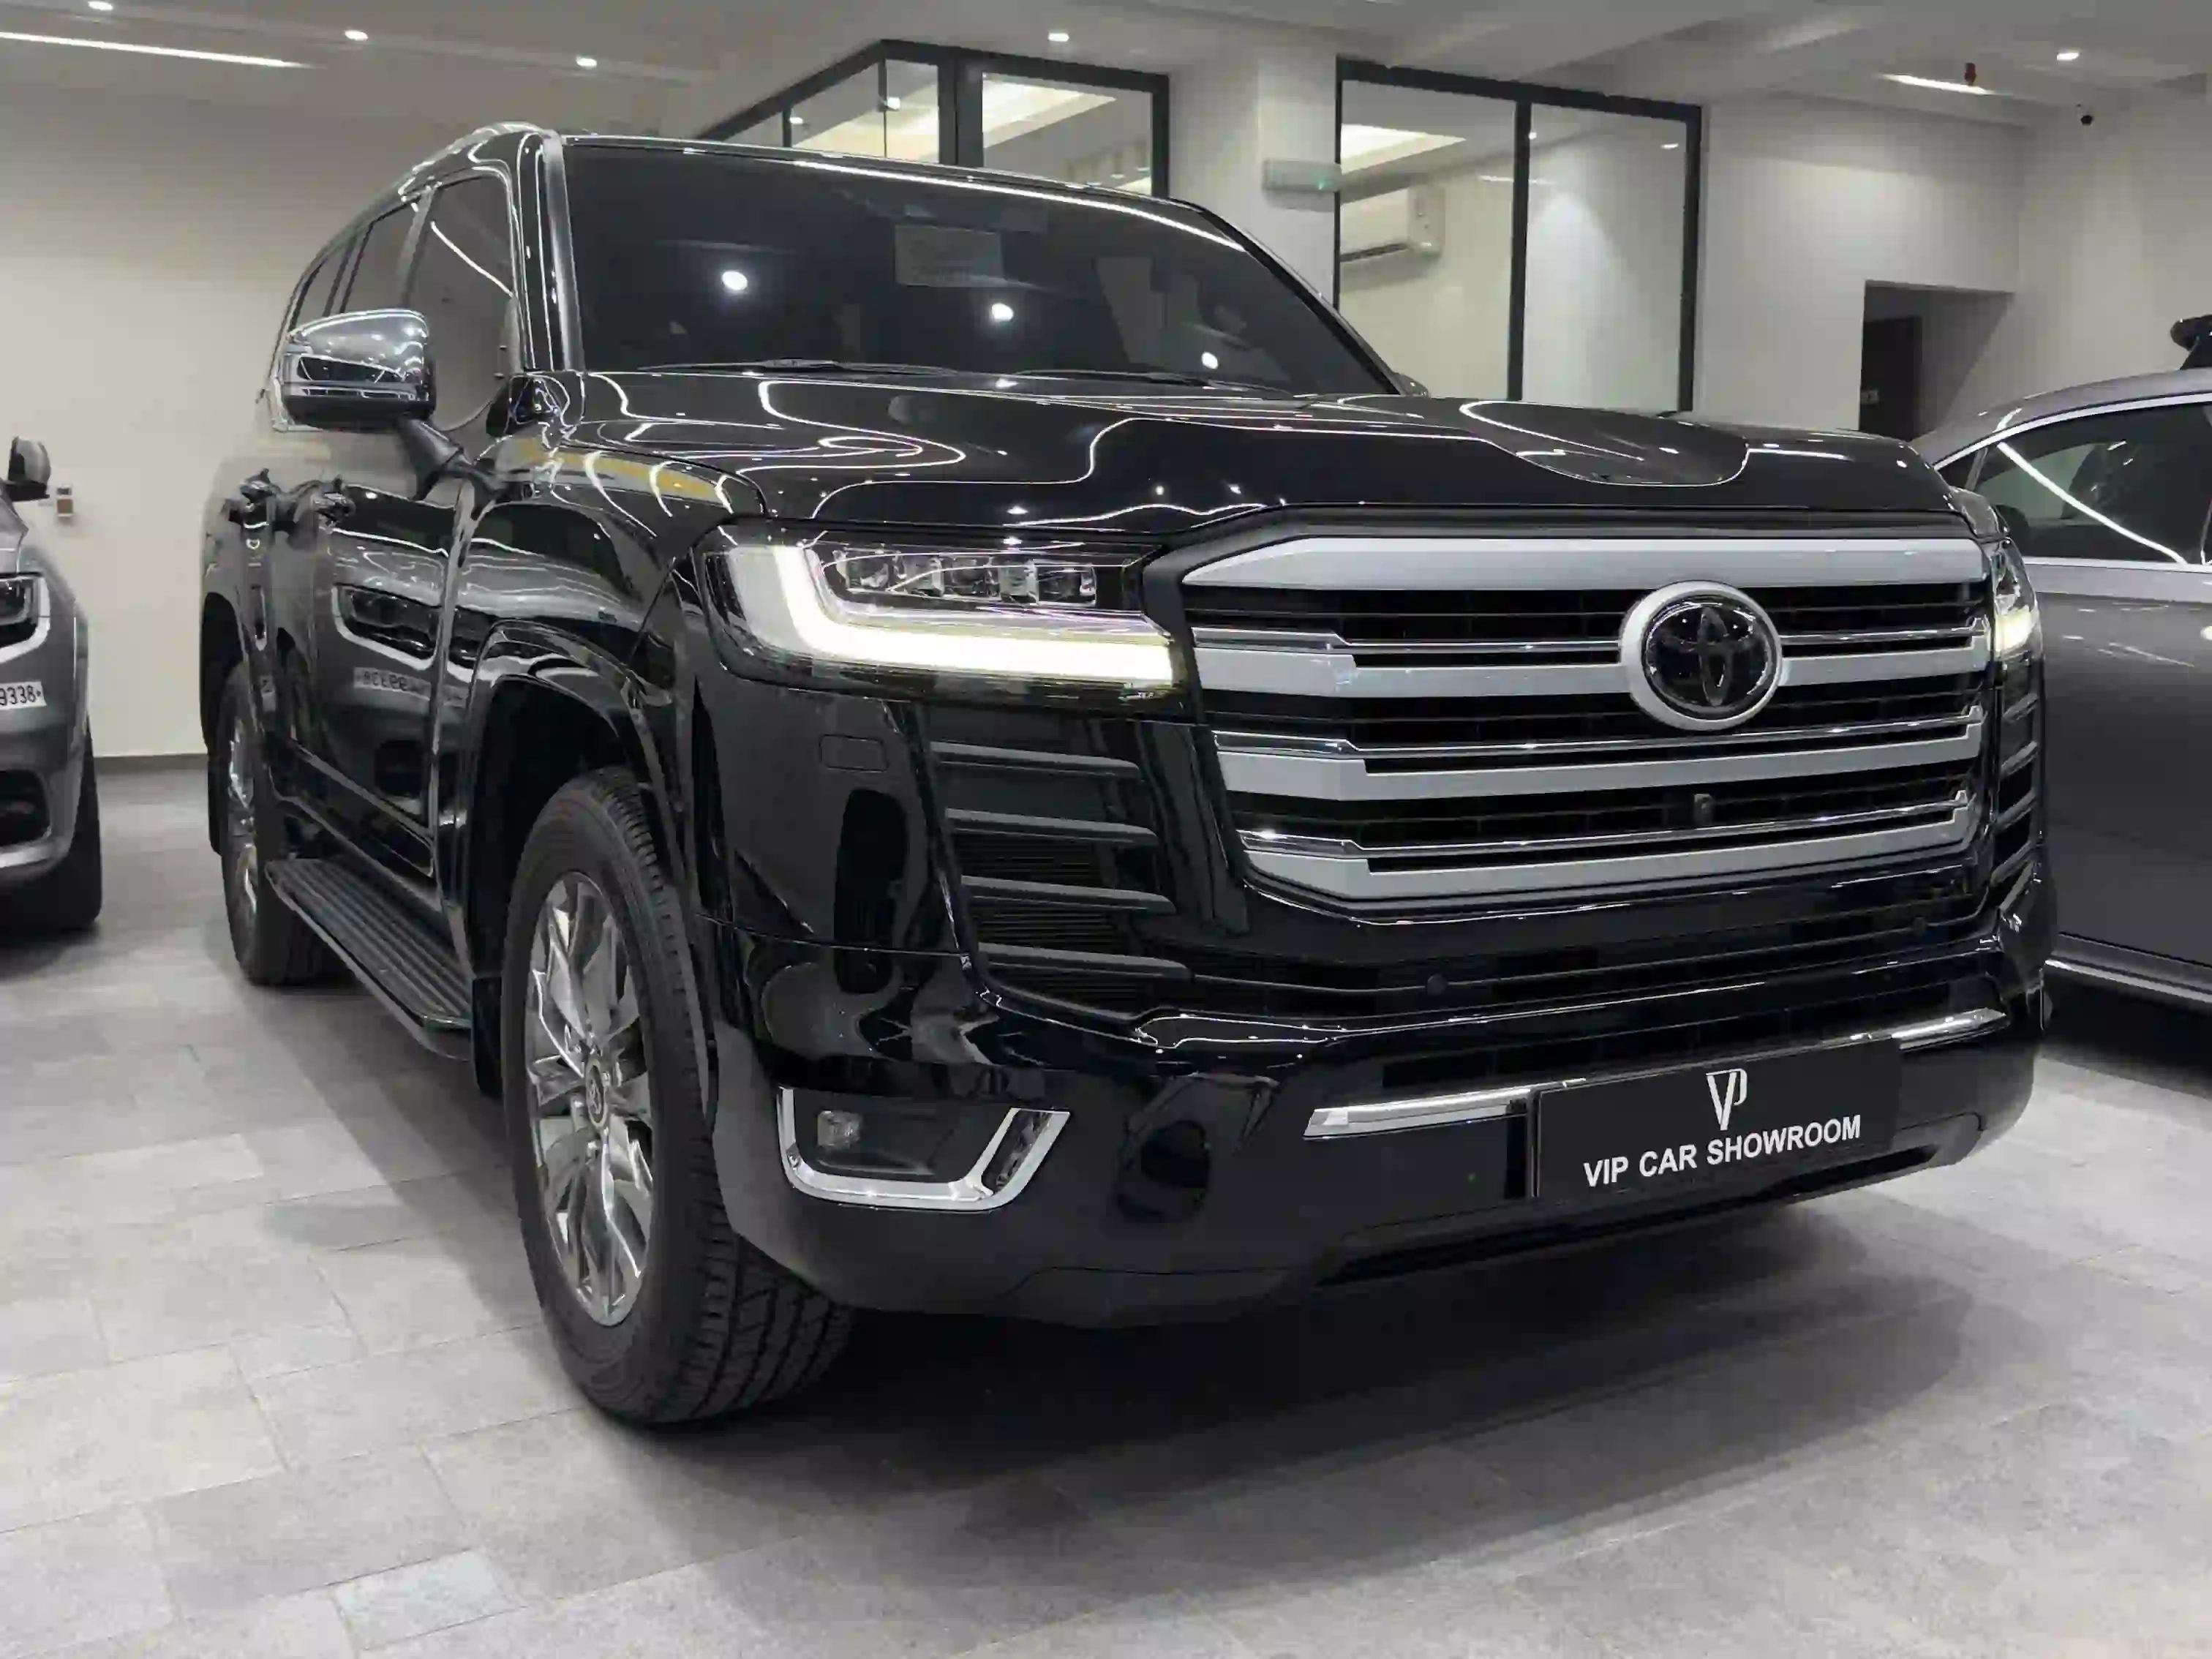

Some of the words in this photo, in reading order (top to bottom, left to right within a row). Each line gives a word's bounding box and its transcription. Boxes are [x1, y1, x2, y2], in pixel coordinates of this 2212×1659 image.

[1583, 1156, 1629, 1187] VIP
[1639, 1144, 1698, 1177] CAR
[1707, 1114, 1861, 1165] SHOWROOM
